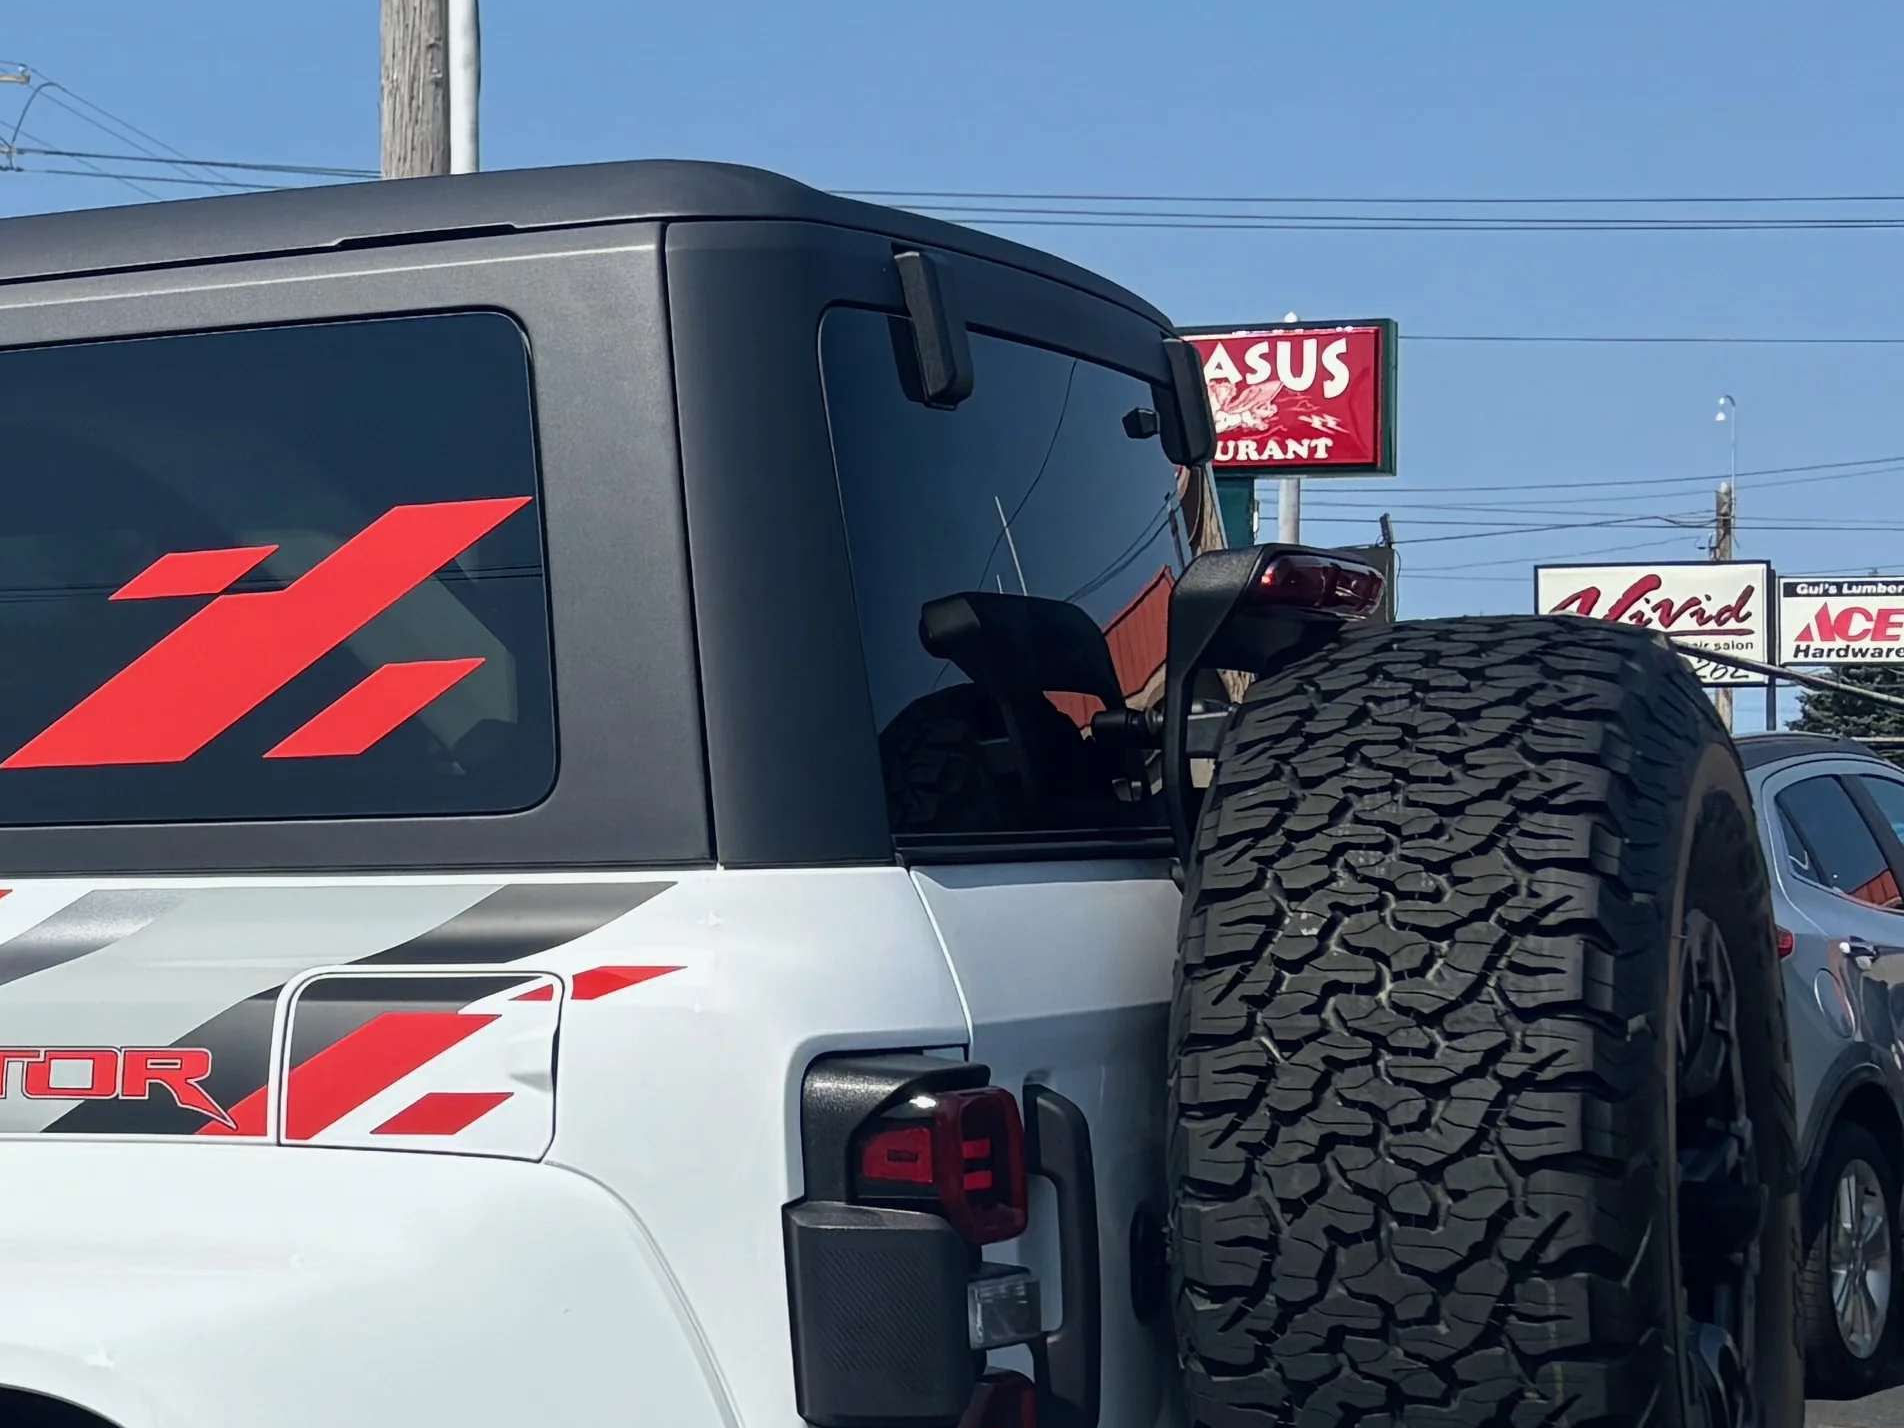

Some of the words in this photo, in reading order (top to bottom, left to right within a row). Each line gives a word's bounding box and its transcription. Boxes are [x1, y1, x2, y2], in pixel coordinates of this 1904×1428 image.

[1203, 337, 1350, 399] ASUS
[1213, 436, 1334, 462] URANT
[1549, 573, 1756, 629] Vivid
[1793, 601, 1904, 642] ACE
[1713, 641, 1754, 652] salon
[1793, 644, 1904, 659] Hardware
